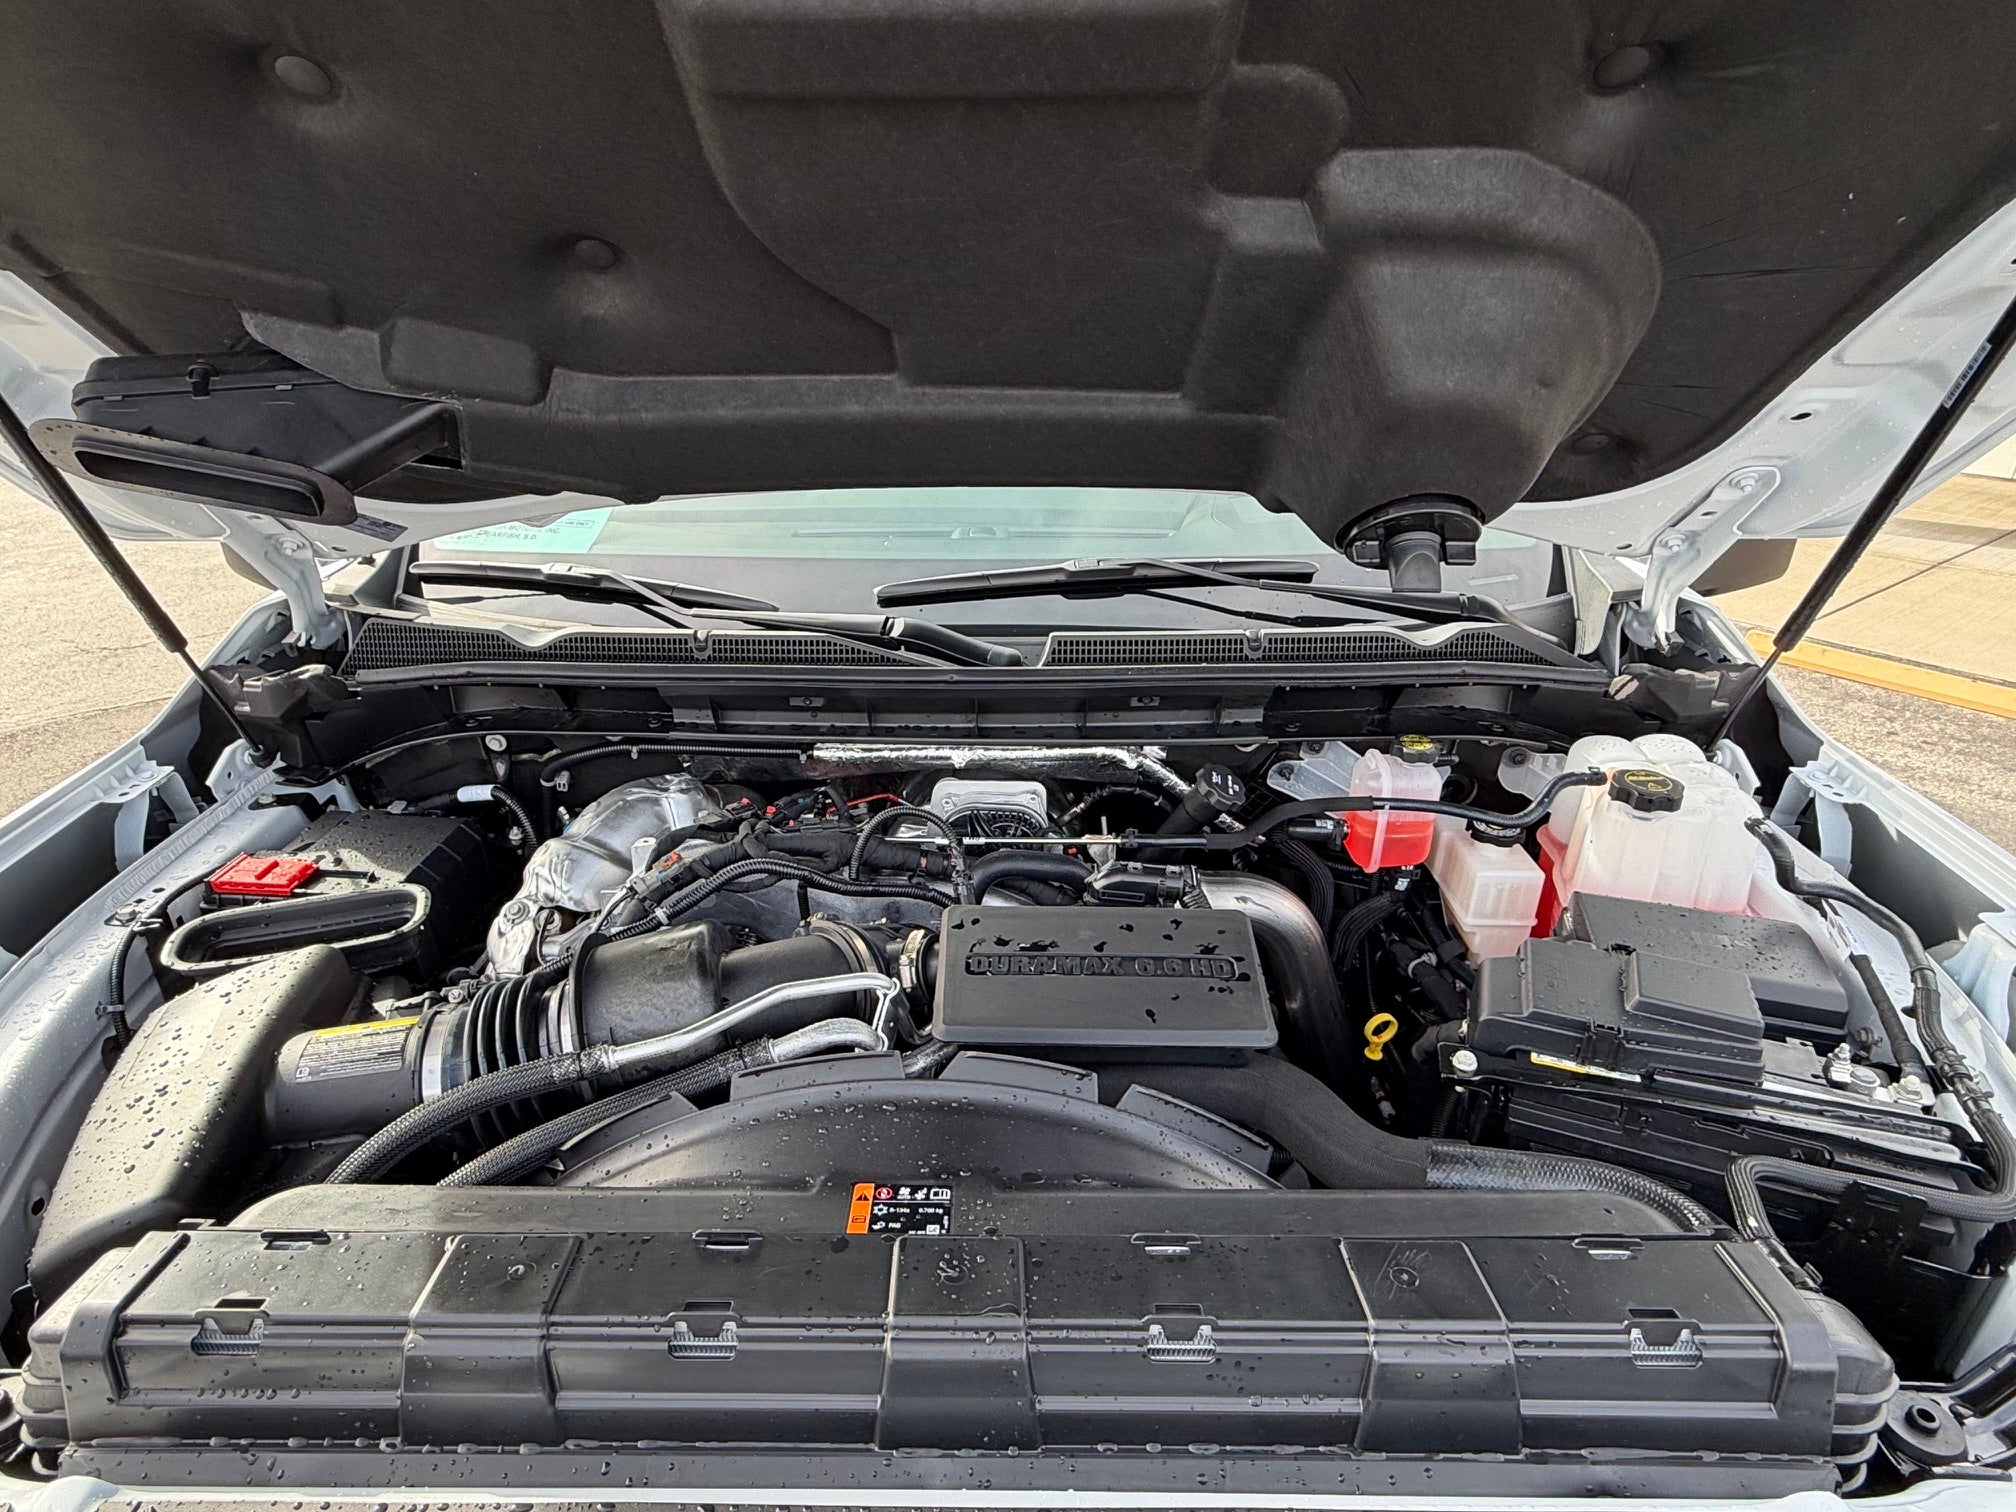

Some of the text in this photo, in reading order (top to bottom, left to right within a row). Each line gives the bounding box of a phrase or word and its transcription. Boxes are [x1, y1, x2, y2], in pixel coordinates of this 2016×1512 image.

[970, 955, 1234, 979] DURAMAX 6.6 HD
